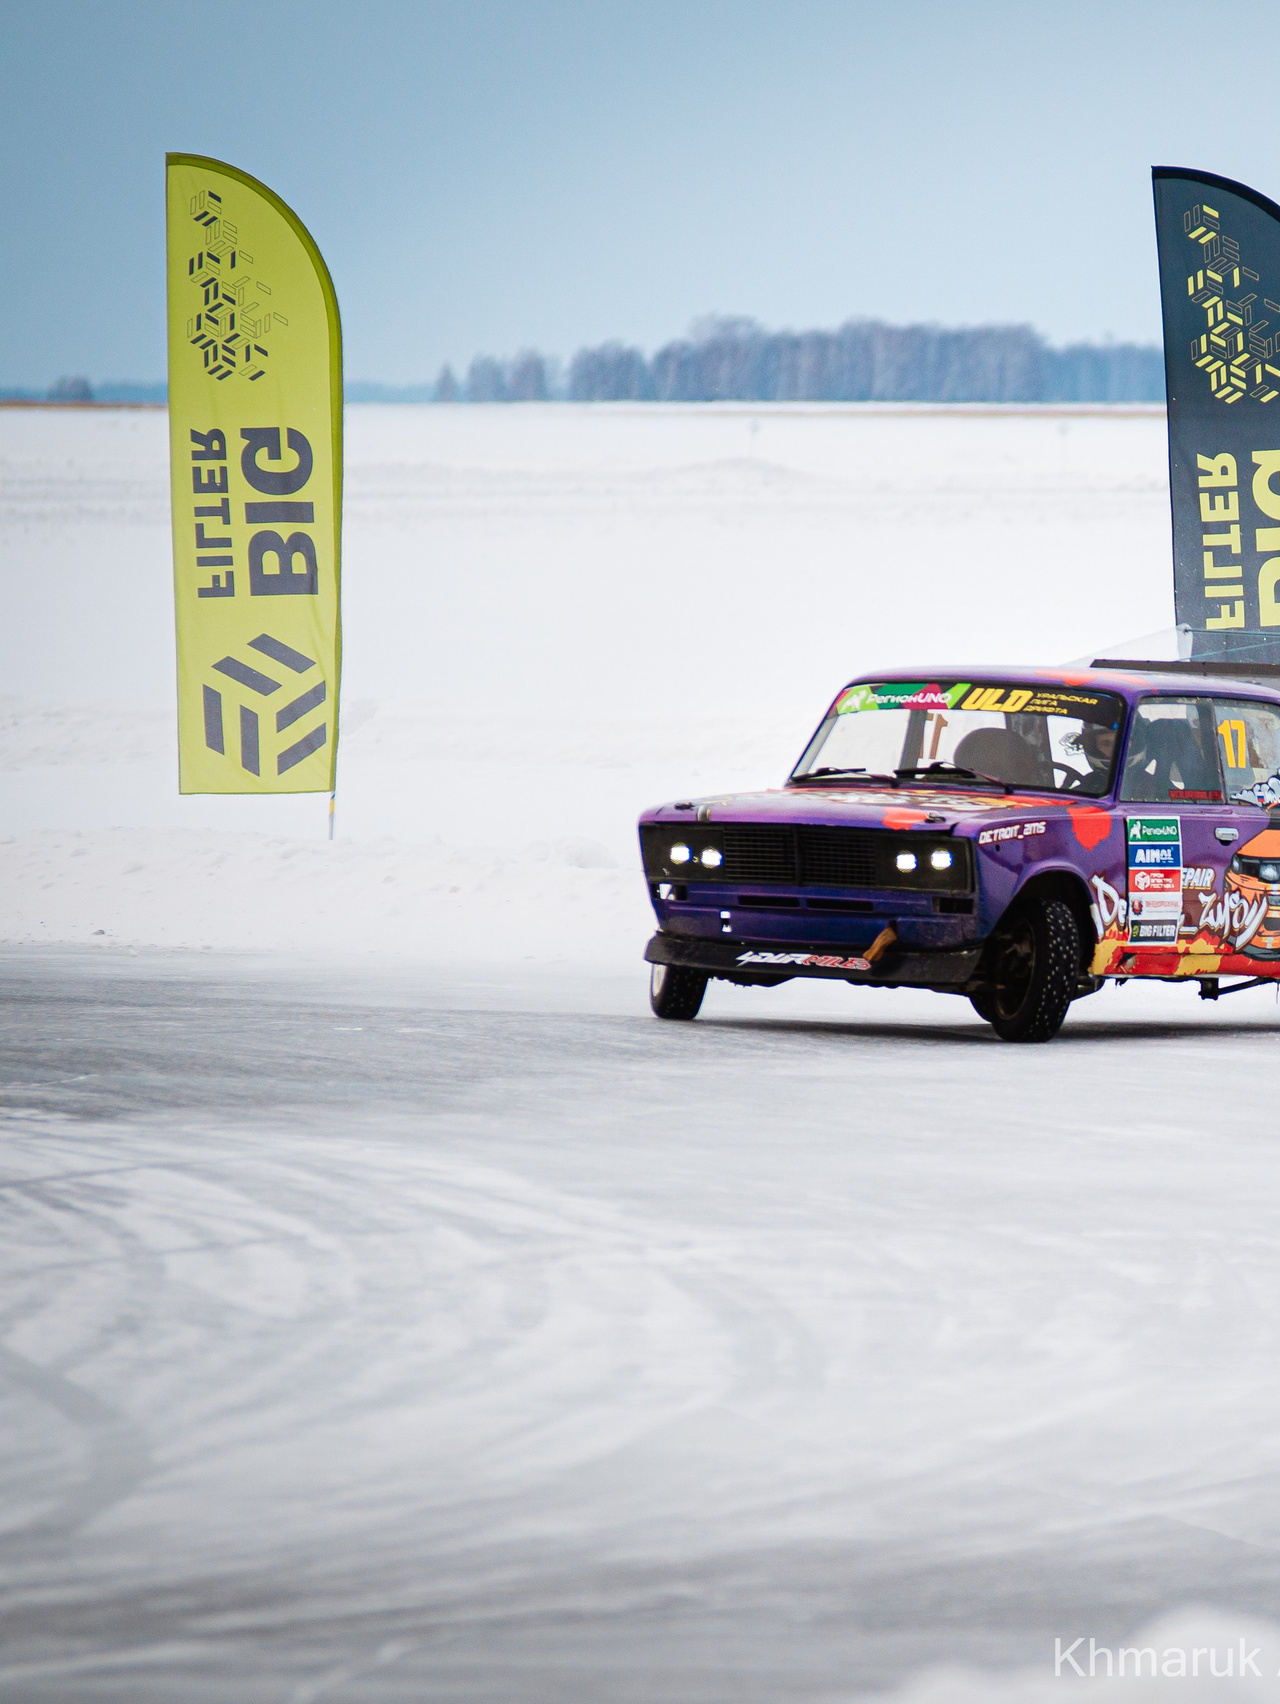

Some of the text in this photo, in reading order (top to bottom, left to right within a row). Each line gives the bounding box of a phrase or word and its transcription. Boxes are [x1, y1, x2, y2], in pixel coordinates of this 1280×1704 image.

[960, 687, 1035, 713] ULD
[1217, 719, 1247, 769] 17
[1182, 867, 1214, 889] EPAIR
